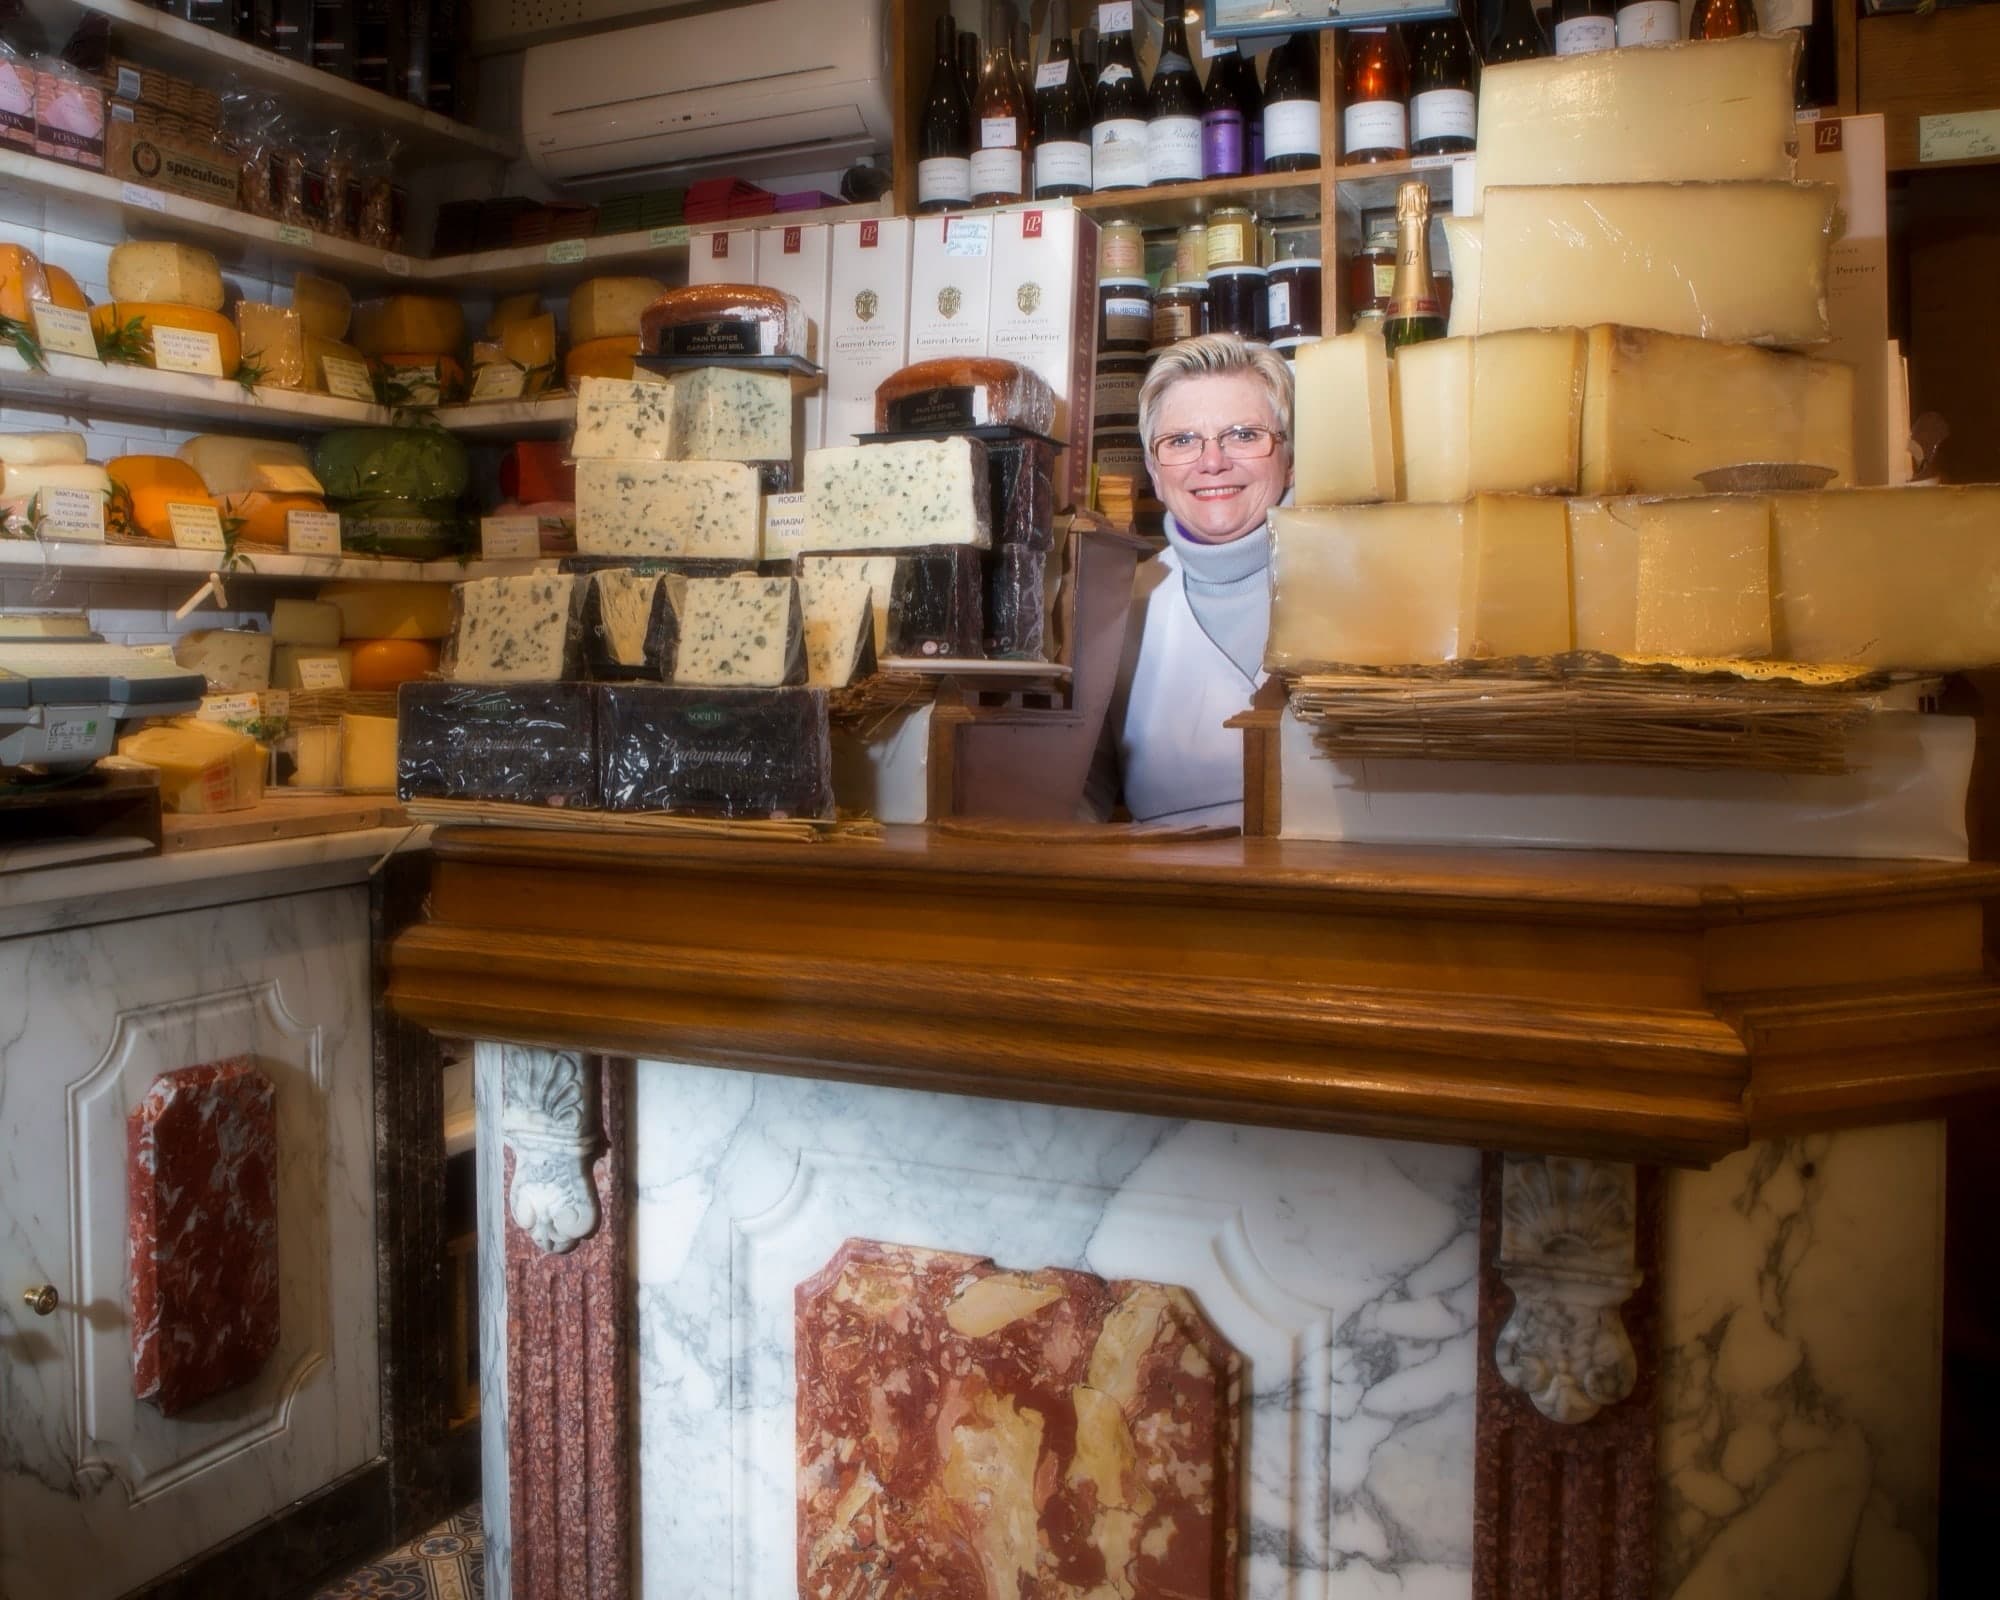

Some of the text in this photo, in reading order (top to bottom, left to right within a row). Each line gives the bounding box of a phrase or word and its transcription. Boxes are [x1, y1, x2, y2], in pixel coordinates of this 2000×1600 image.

[166, 160, 236, 190] speculoos
[916, 336, 981, 345] Laurent-Perrier
[995, 332, 1061, 344] Laurent-Perrier
[835, 339, 897, 349] Laurent-Perrier
[770, 518, 804, 527] BARAGNA
